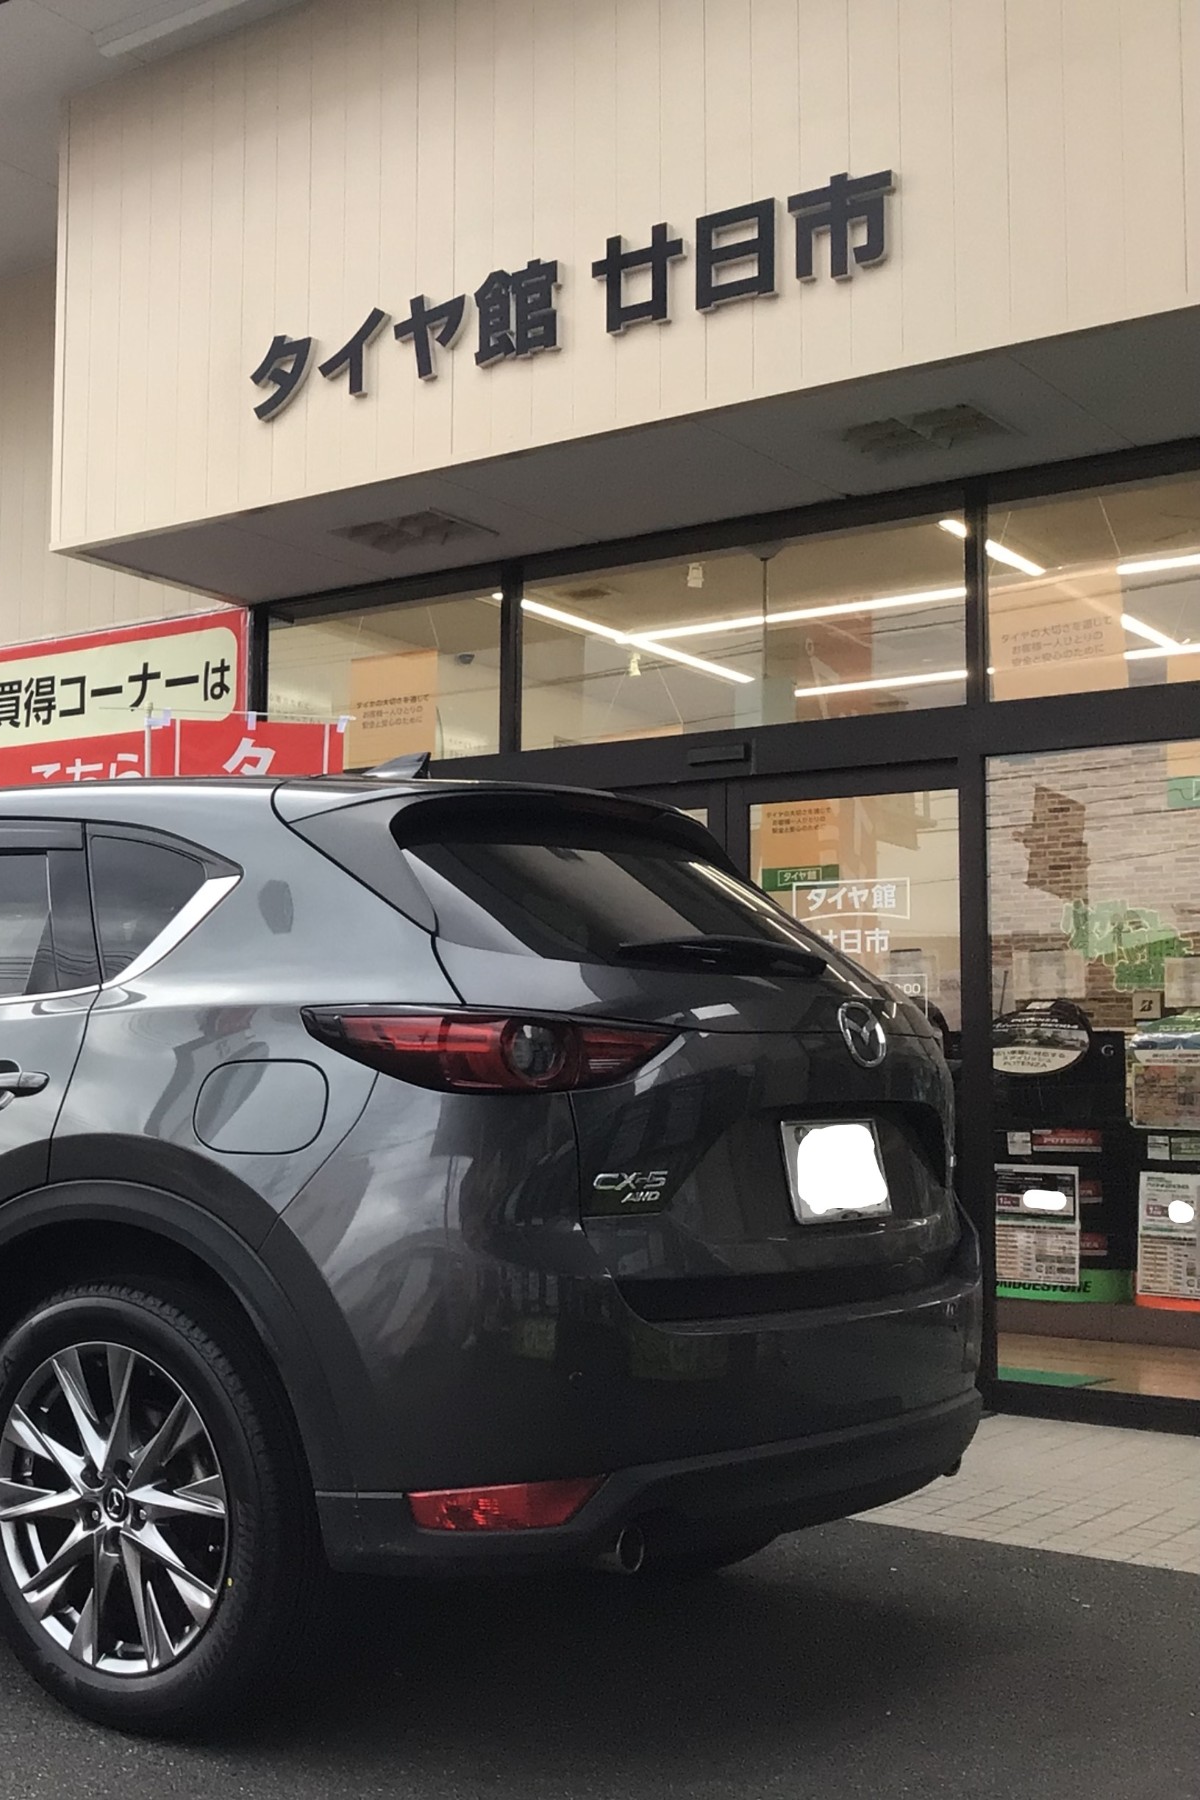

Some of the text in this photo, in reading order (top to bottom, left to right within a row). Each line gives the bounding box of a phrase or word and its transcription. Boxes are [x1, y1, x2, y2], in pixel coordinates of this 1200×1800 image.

[249, 169, 898, 424] タイヤ館 廿日市
[806, 883, 897, 911] タイヤ館
[593, 1171, 668, 1190] CX-5
[621, 1191, 660, 1203] AWD
[995, 1280, 1093, 1294] RIDGESTONE
